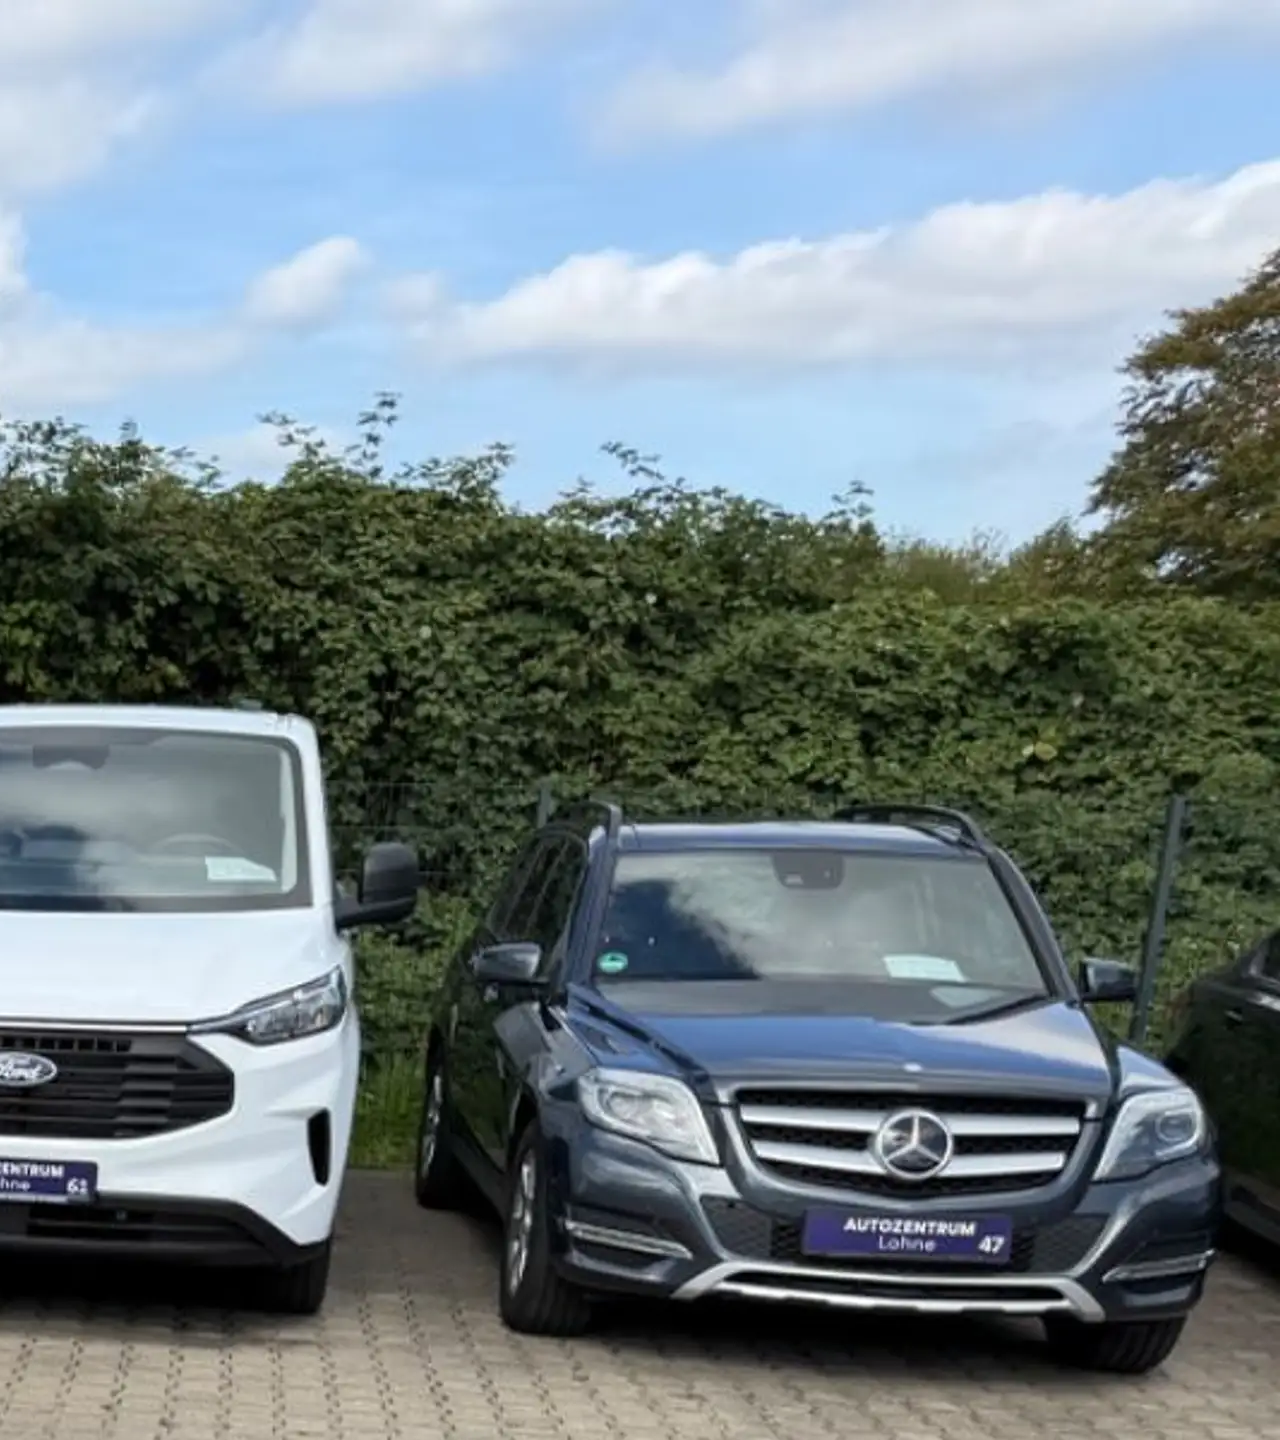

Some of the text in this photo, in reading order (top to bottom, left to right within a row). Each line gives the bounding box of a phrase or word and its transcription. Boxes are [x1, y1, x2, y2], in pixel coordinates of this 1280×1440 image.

[843, 1216, 978, 1238] AUTOZENTRUM
[878, 1235, 937, 1252] Lohne
[978, 1235, 1006, 1255] 47
